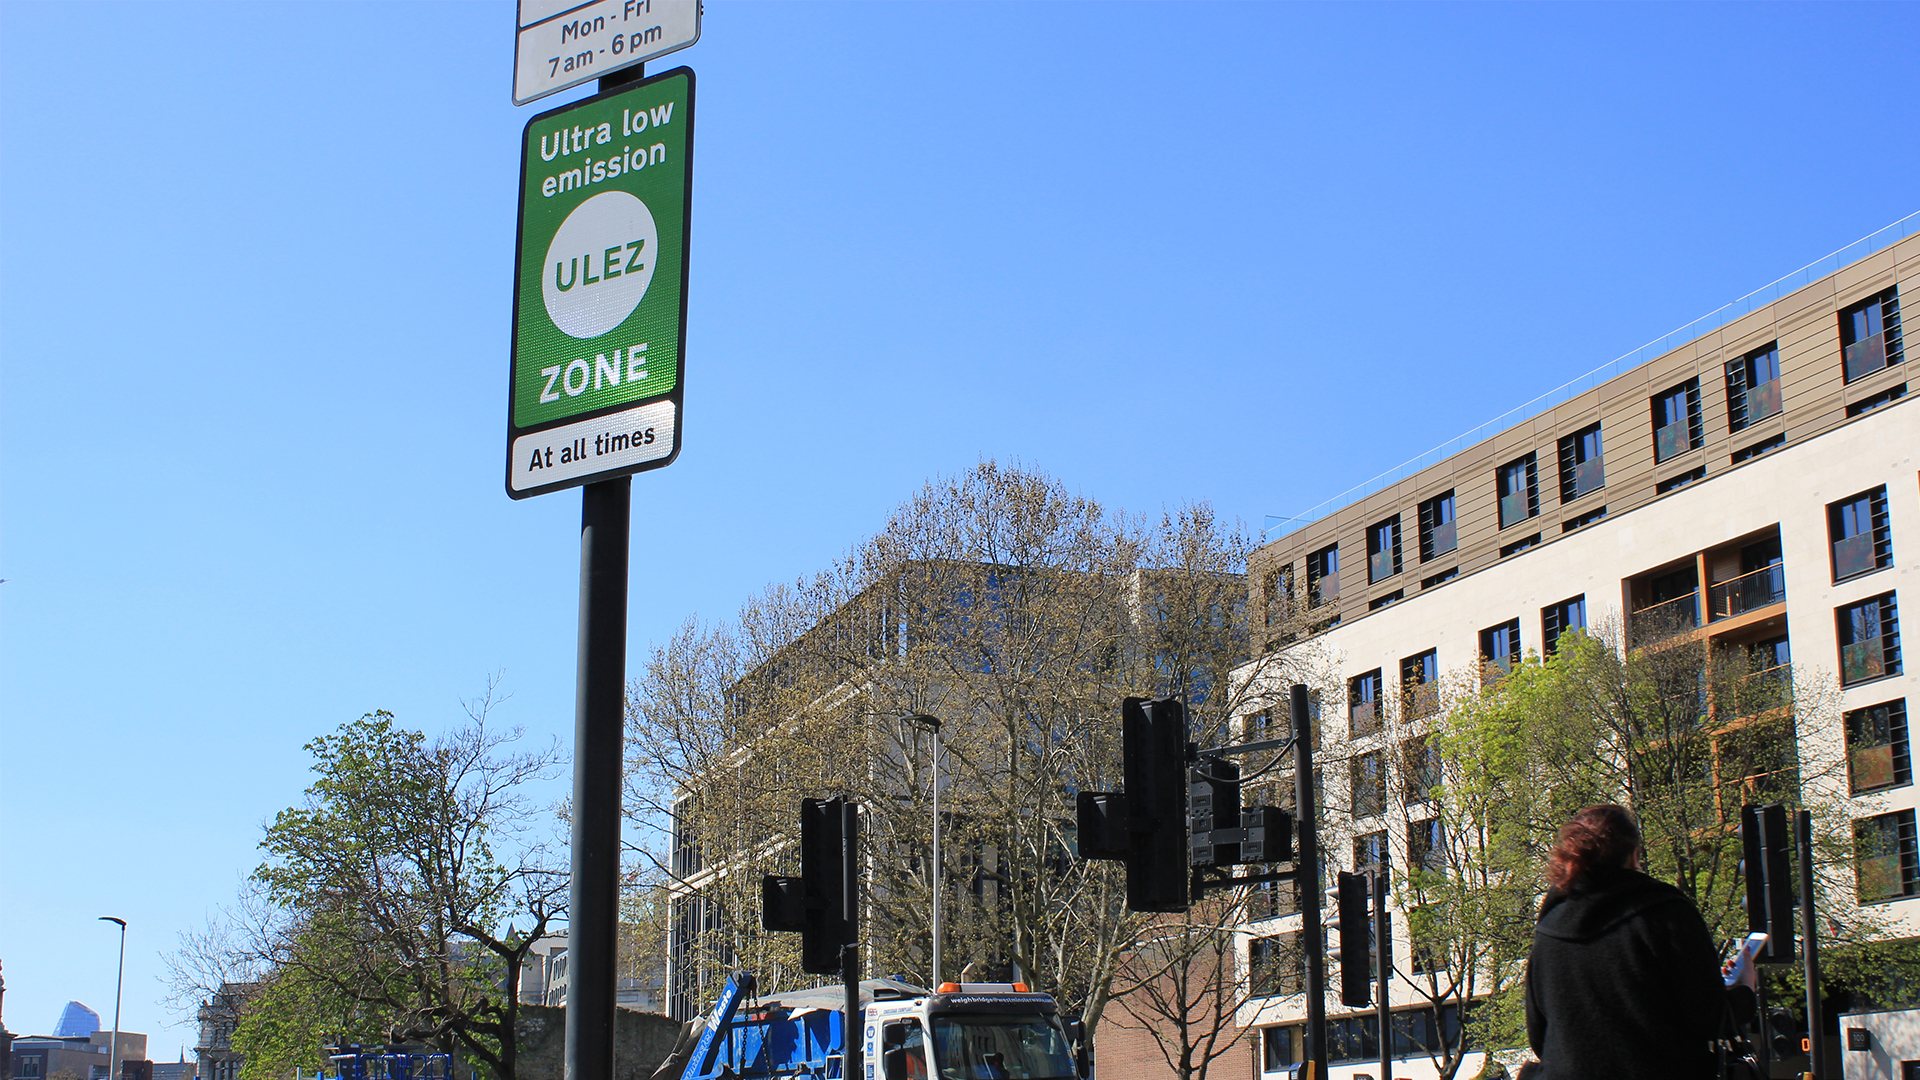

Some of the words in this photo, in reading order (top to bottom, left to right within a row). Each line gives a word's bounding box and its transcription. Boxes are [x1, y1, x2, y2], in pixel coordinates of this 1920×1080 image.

[561, 14, 605, 44] Mon
[623, 0, 651, 22] Fri
[540, 121, 612, 162] Ultra
[622, 101, 675, 137] low
[541, 142, 667, 198] emission
[556, 239, 646, 293] ULEZ
[539, 342, 649, 405] ZONE
[528, 446, 553, 472] At
[560, 437, 587, 465] all
[594, 427, 656, 456] times
[707, 989, 732, 1032] Waste
